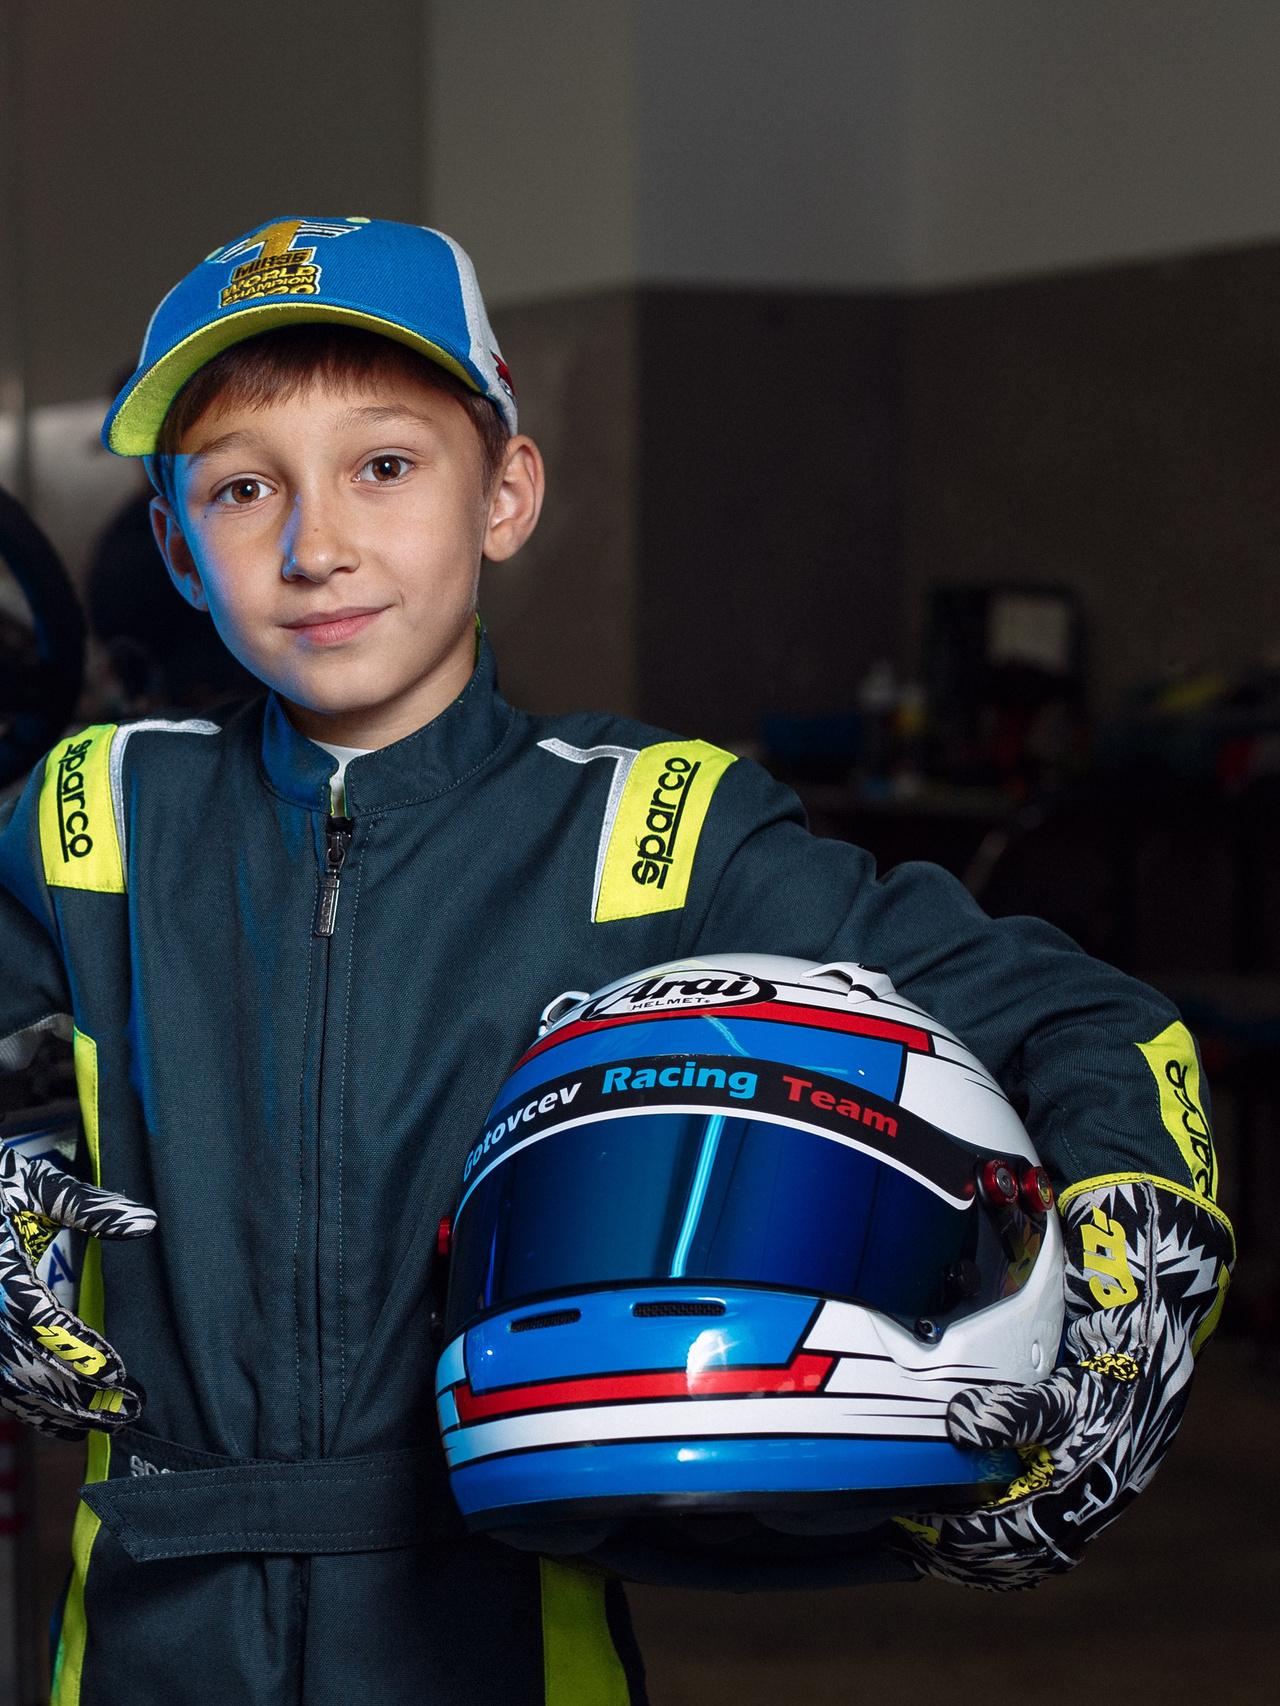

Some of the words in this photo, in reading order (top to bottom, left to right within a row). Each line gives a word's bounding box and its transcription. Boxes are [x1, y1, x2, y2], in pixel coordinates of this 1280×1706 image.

[221, 275, 314, 307] CHAMPION
[222, 265, 316, 298] WORLD
[58, 738, 94, 863] sparco
[631, 757, 702, 889] sparco
[606, 974, 757, 1006] Arai
[462, 1082, 583, 1182] Gotovcev
[601, 1060, 759, 1100] Racing
[782, 1074, 899, 1139] Team
